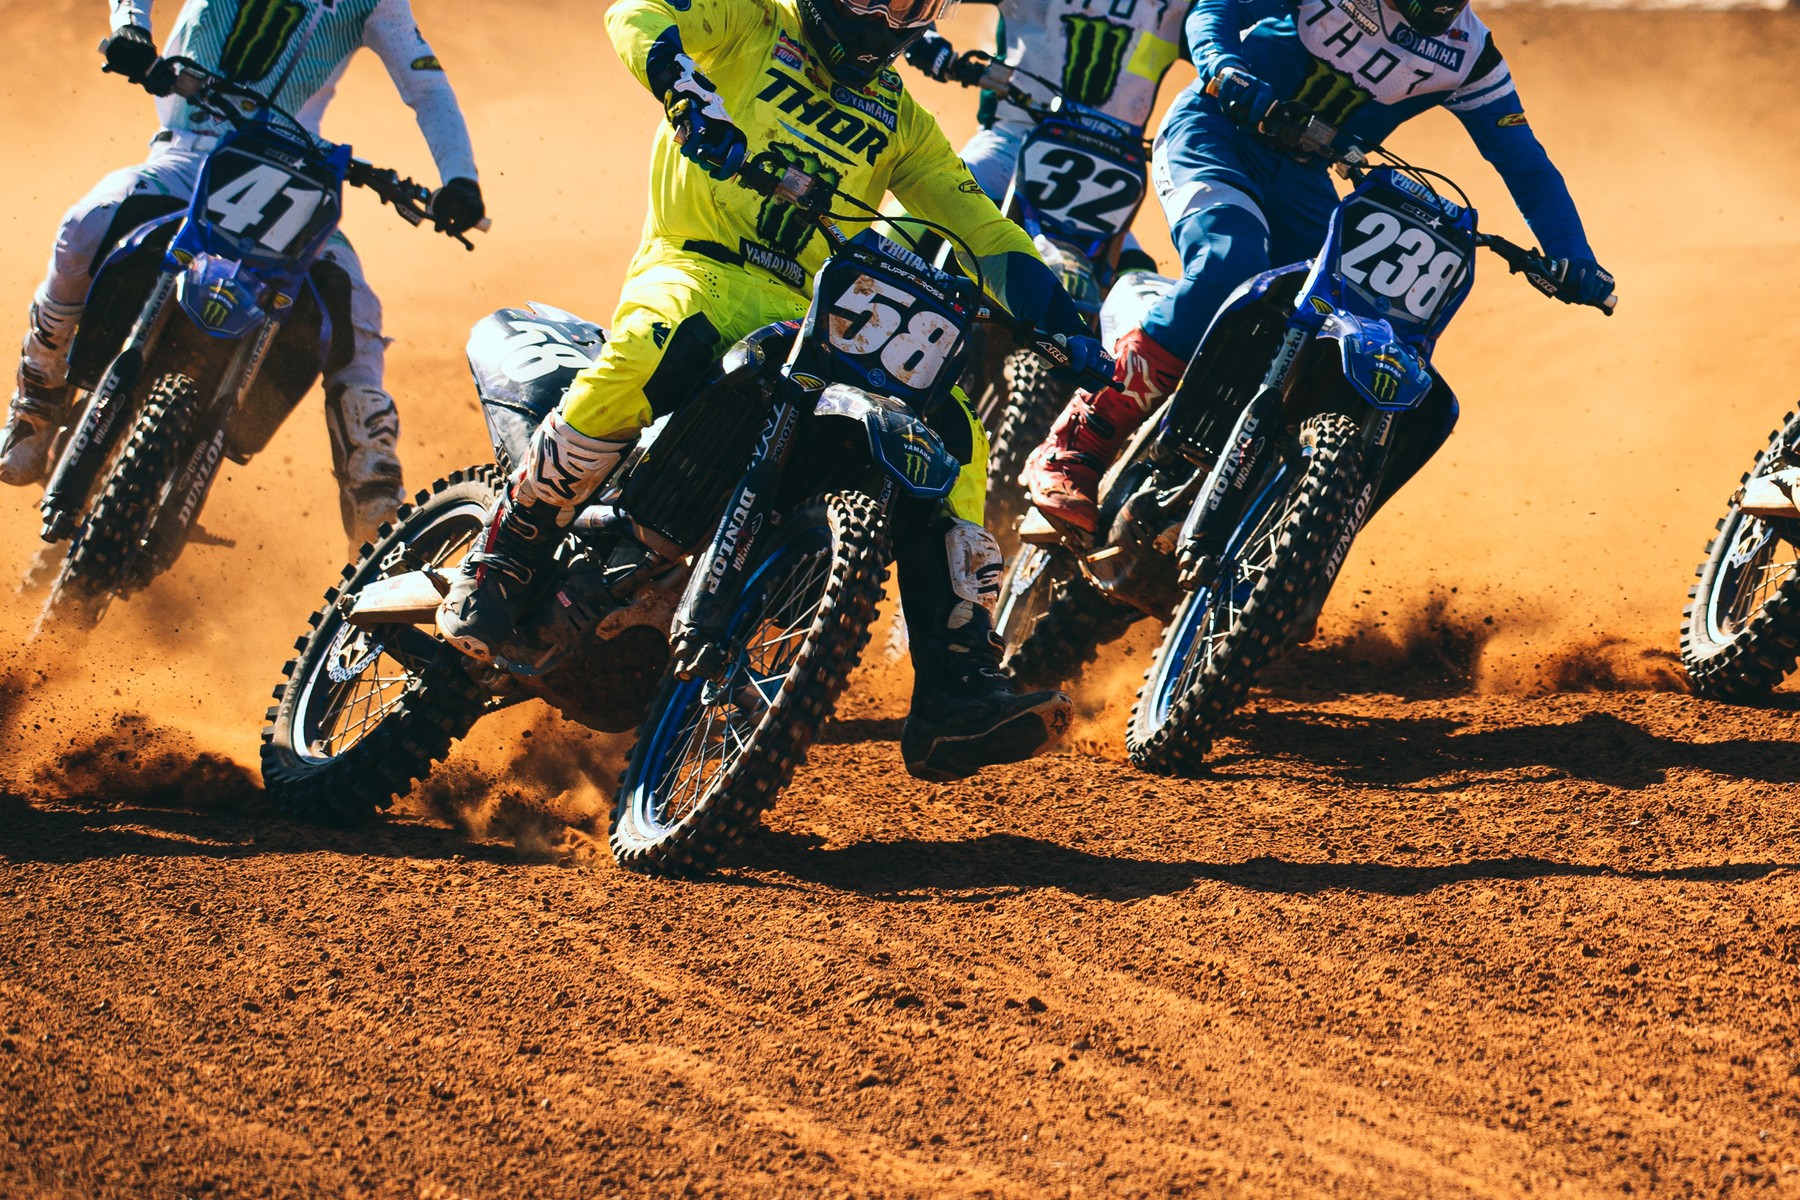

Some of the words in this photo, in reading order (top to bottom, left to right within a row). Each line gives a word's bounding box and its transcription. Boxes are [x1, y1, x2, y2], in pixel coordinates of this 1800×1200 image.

[777, 48, 799, 68] 100%
[756, 67, 889, 167] THOR
[850, 93, 896, 129] YAMAHA
[207, 164, 331, 253] 41
[1025, 148, 1142, 234] 32
[745, 243, 804, 285] YAMALUBE
[880, 261, 945, 300] SUPERCROSS
[1341, 212, 1467, 320] 238
[1528, 272, 1558, 293] ARC
[1596, 269, 1615, 285] THOR
[829, 274, 961, 390] 58
[1035, 340, 1068, 363] ARC
[1375, 362, 1402, 379] YAMAHA
[69, 371, 121, 467] DUNLOP
[903, 443, 932, 463] YAMAHA
[179, 428, 225, 528] DUNLOP
[1210, 415, 1260, 511] DUNLOP
[707, 487, 757, 595] DUNLOP
[1325, 483, 1372, 581] DUNLOP
